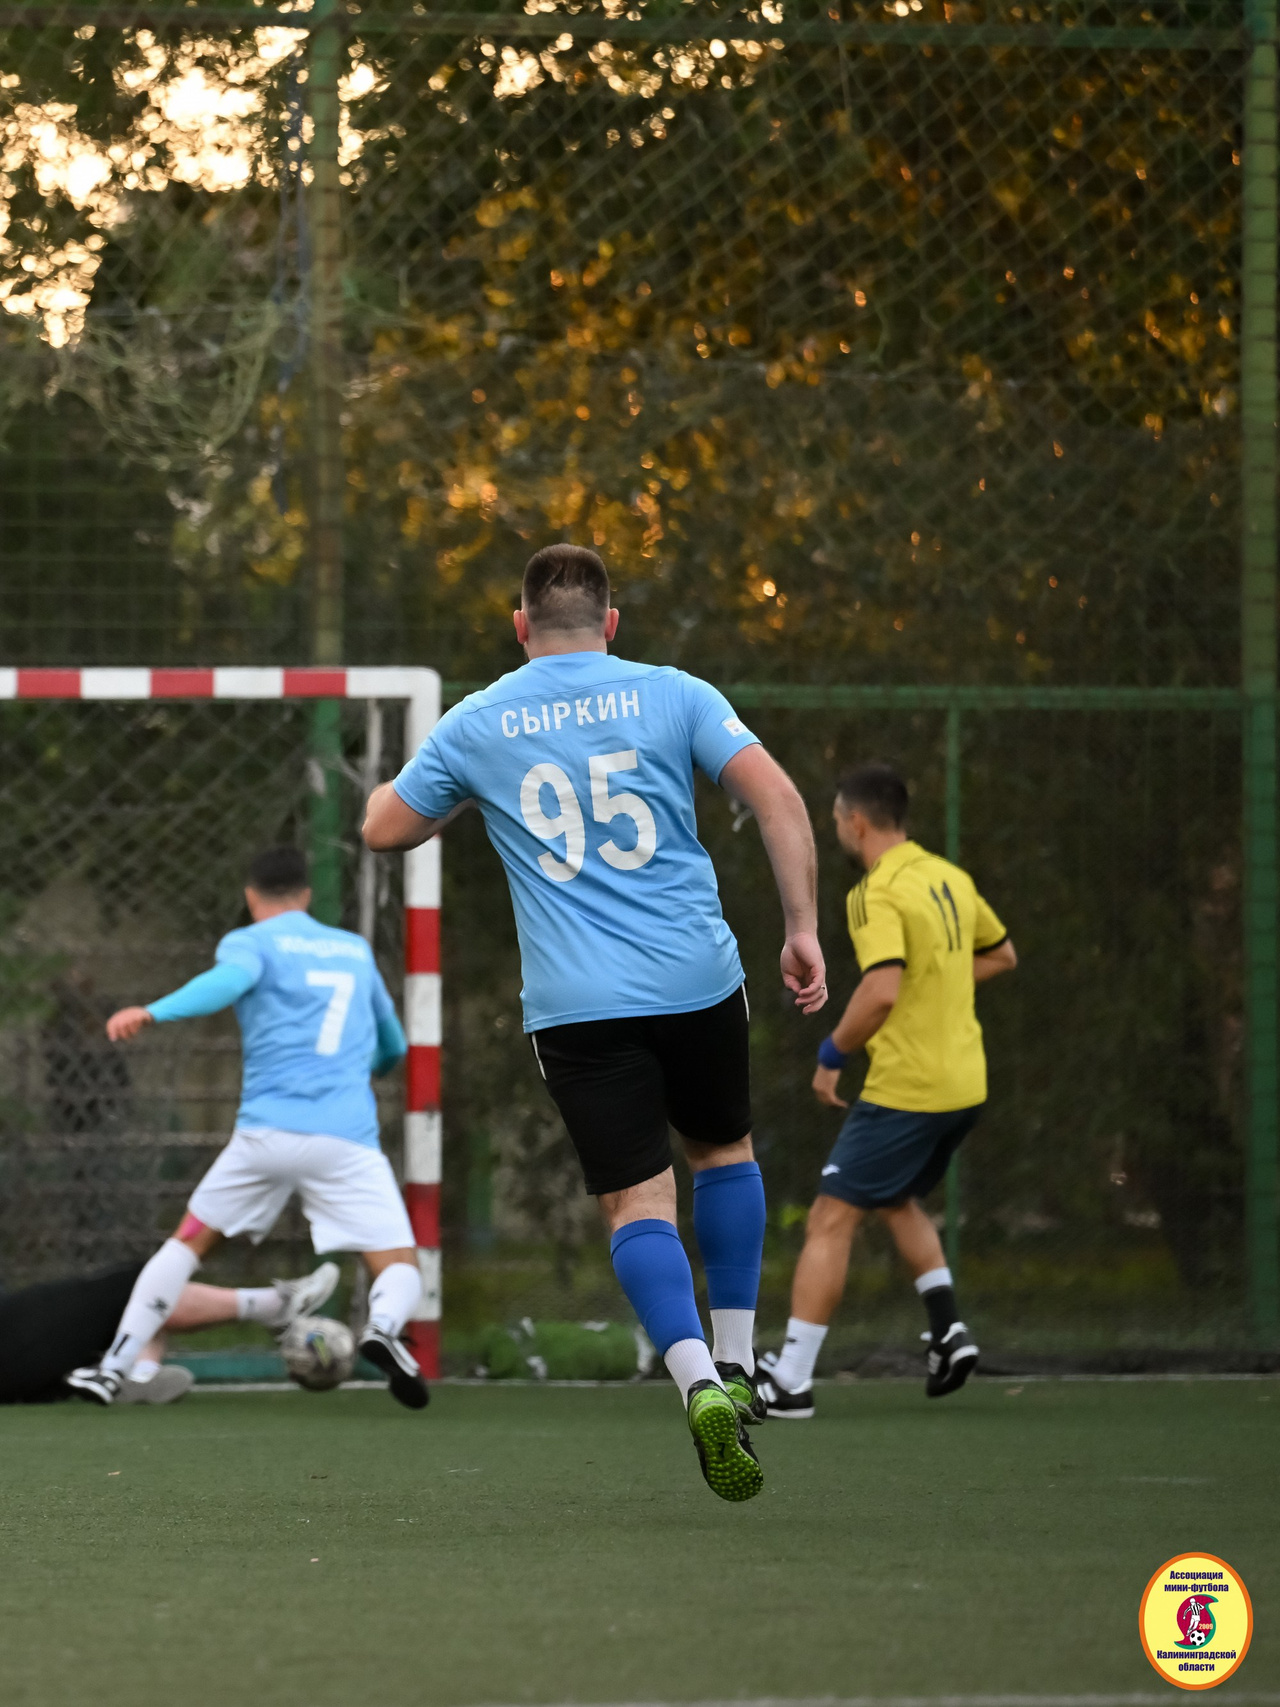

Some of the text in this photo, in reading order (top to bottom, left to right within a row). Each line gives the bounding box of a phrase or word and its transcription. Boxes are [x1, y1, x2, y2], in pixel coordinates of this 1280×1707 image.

[501, 689, 640, 739] СЫРКИН
[520, 749, 658, 882] 95
[305, 970, 356, 1057] 7
